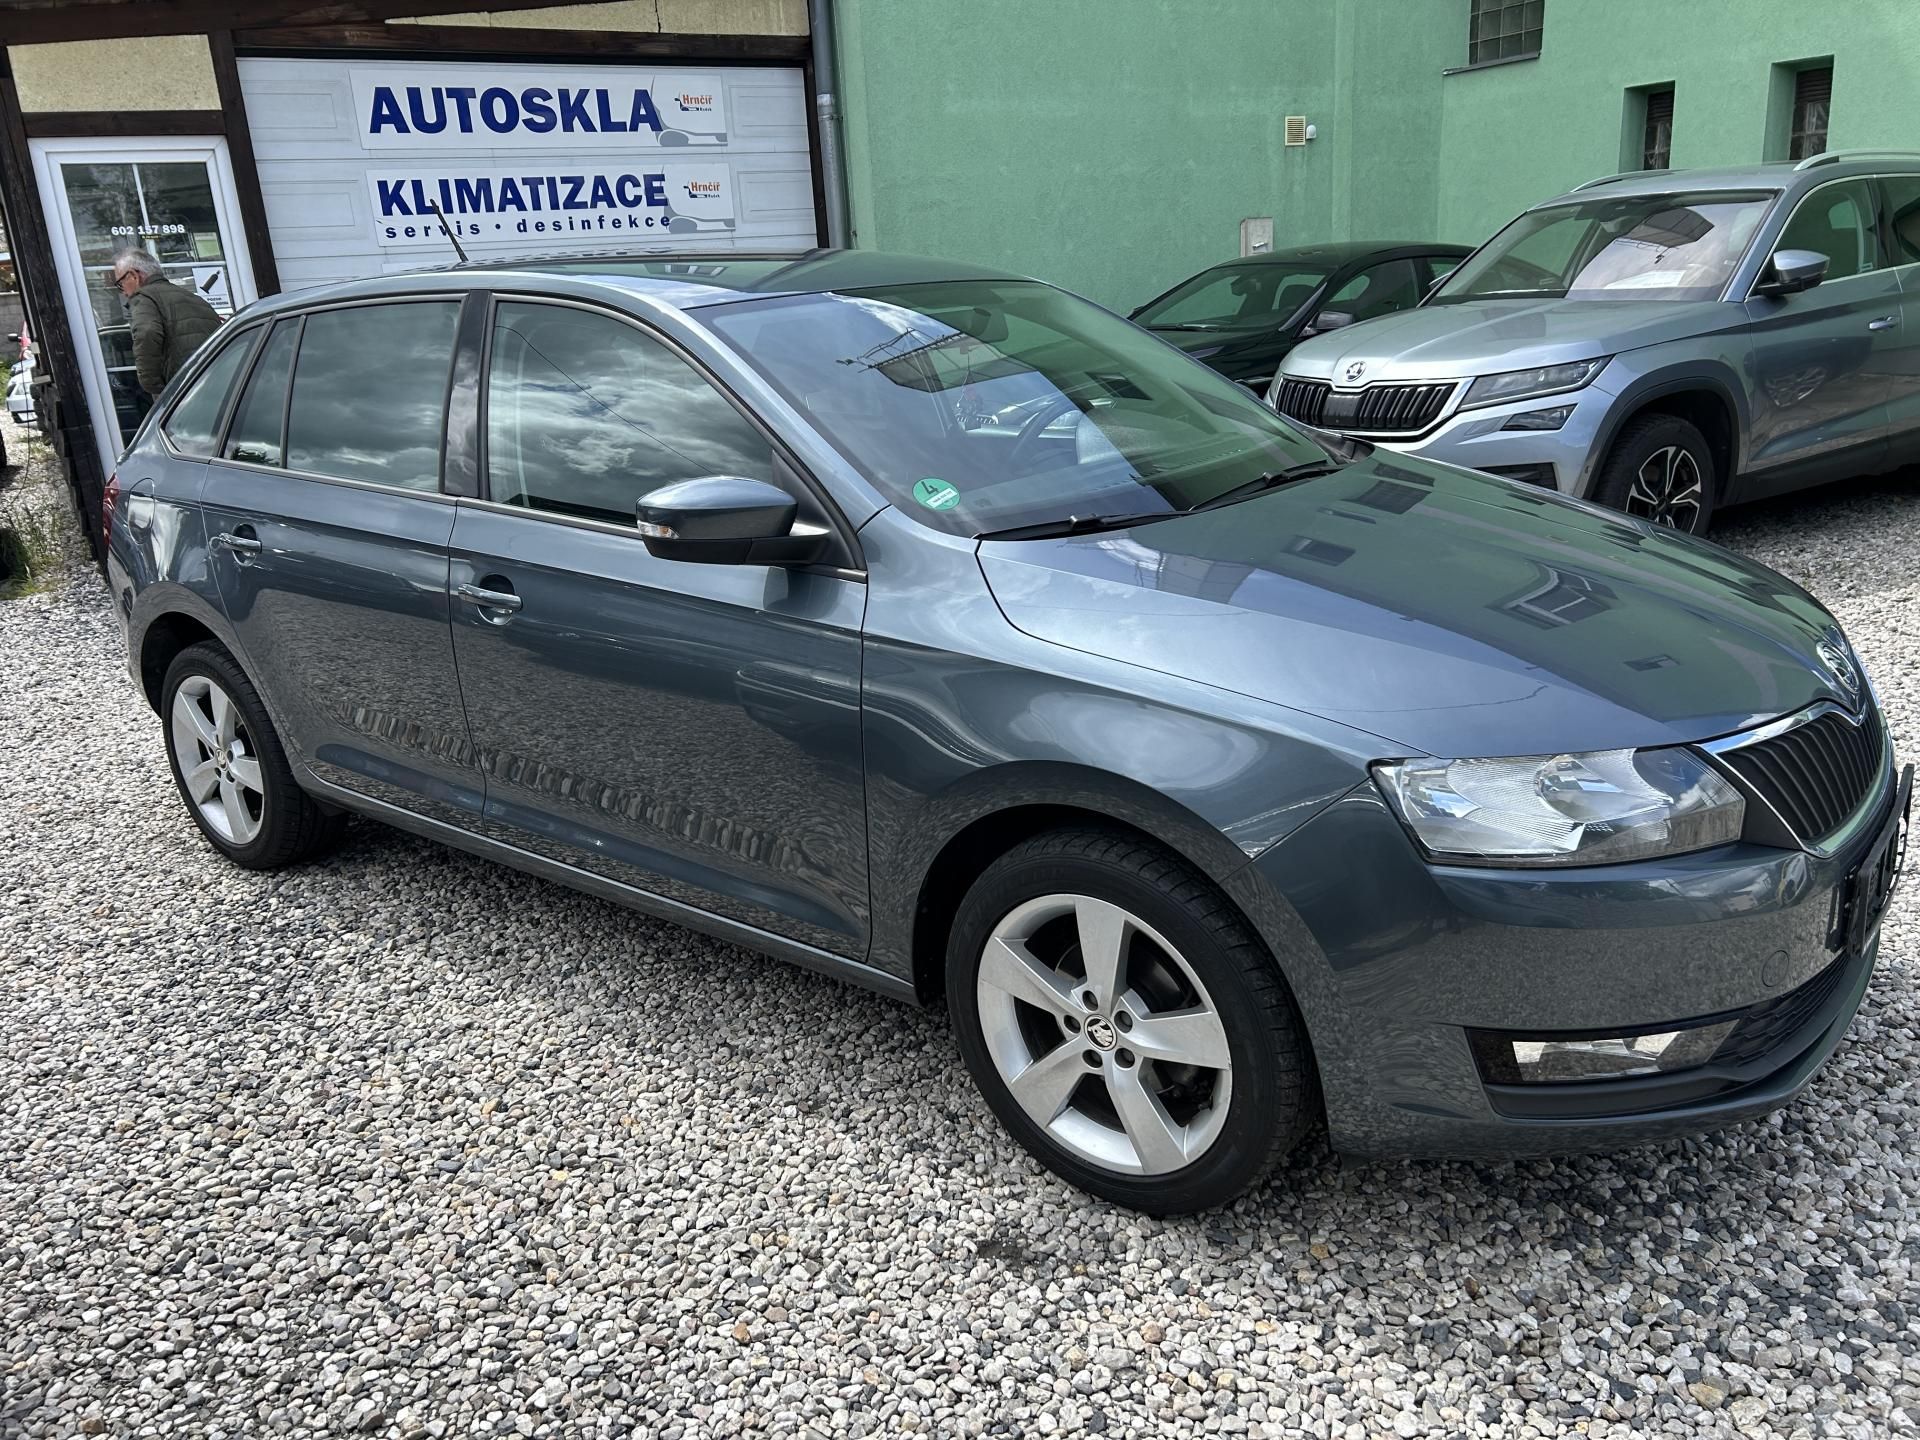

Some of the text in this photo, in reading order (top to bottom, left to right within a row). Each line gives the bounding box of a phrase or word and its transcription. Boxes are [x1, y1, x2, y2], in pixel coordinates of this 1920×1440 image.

[369, 86, 664, 134] AUTOSKLA
[377, 173, 669, 217] KLIMATIZACE
[111, 224, 186, 236] 602 157 898
[385, 214, 670, 239] servis desinfekce
[921, 480, 940, 495] 4
